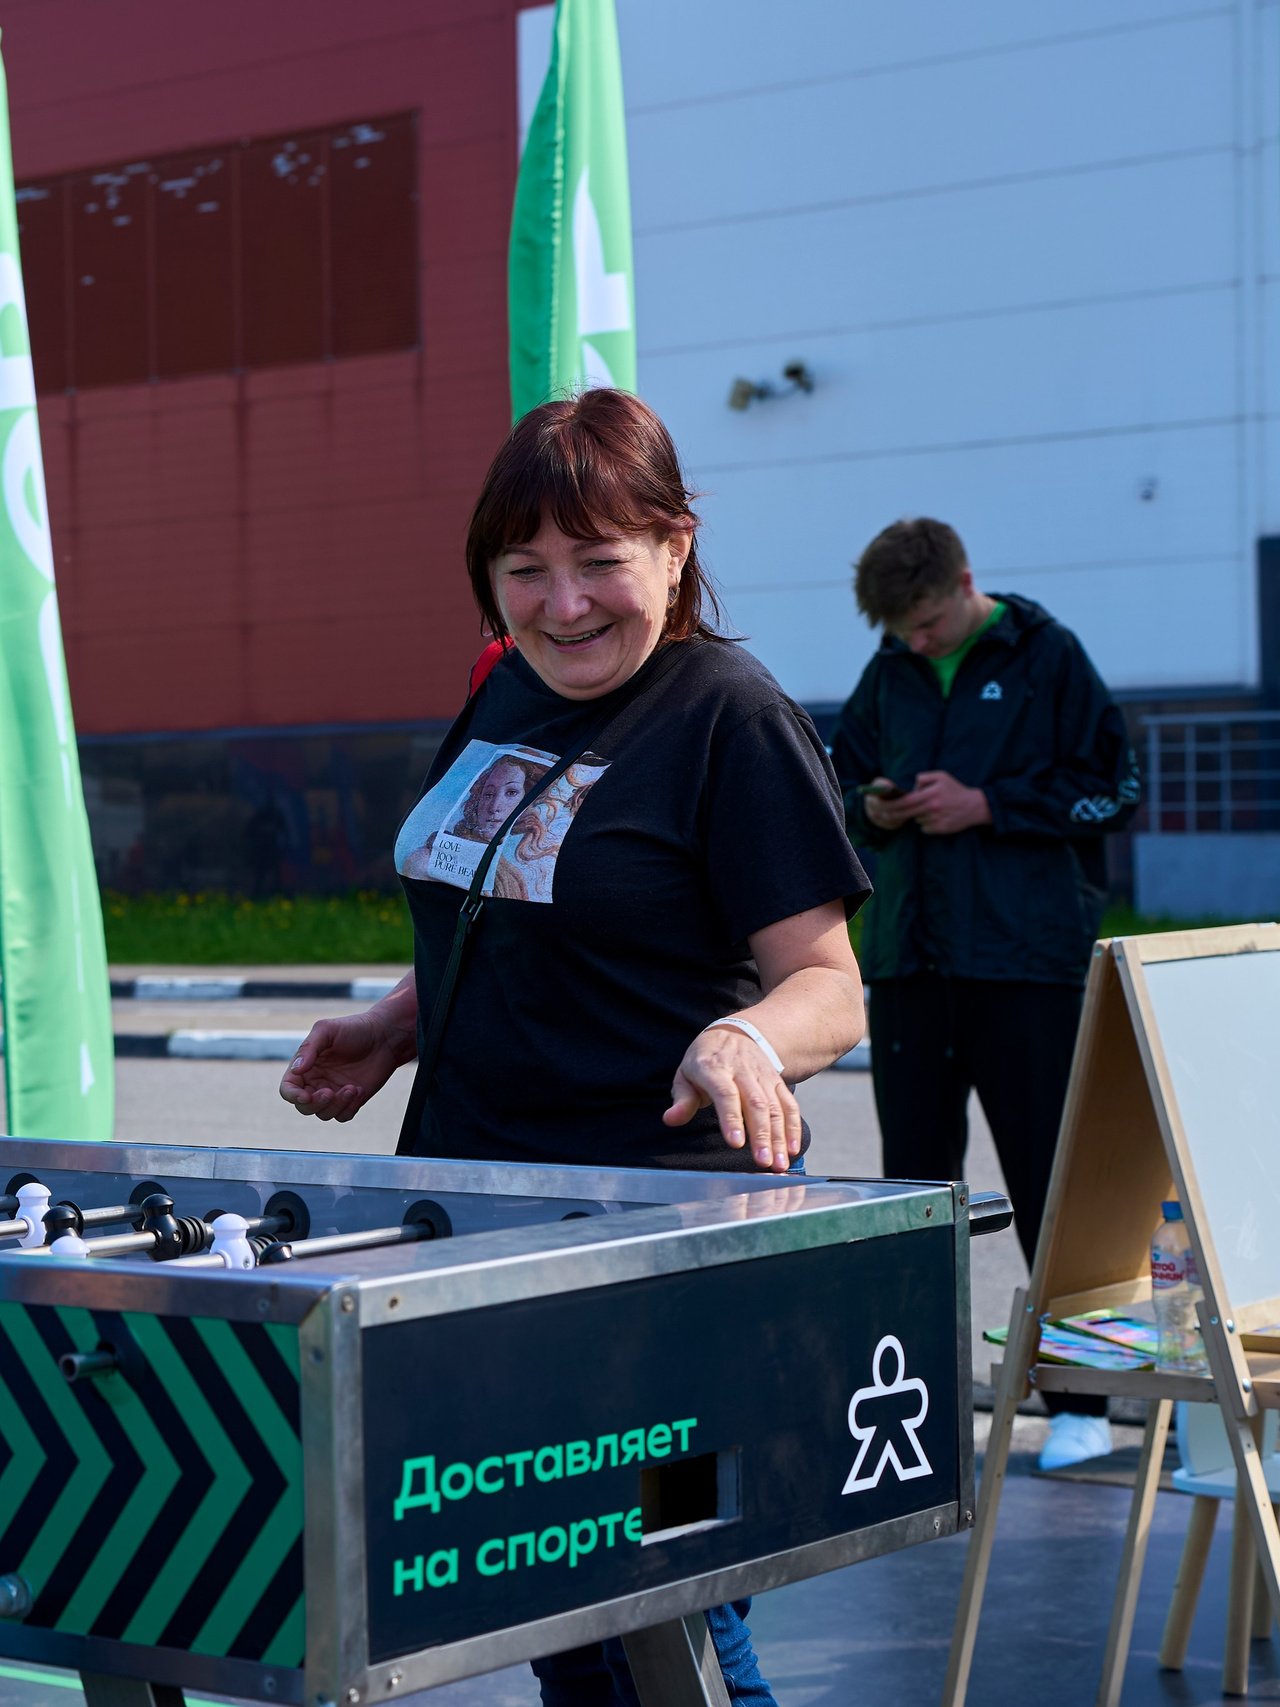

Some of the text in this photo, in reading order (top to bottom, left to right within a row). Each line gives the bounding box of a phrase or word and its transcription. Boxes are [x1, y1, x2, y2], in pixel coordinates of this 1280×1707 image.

[439, 839, 462, 852] LOVE
[434, 859, 476, 878] PURE BEA
[393, 1417, 698, 1522] Доставляет
[393, 1547, 459, 1597] на
